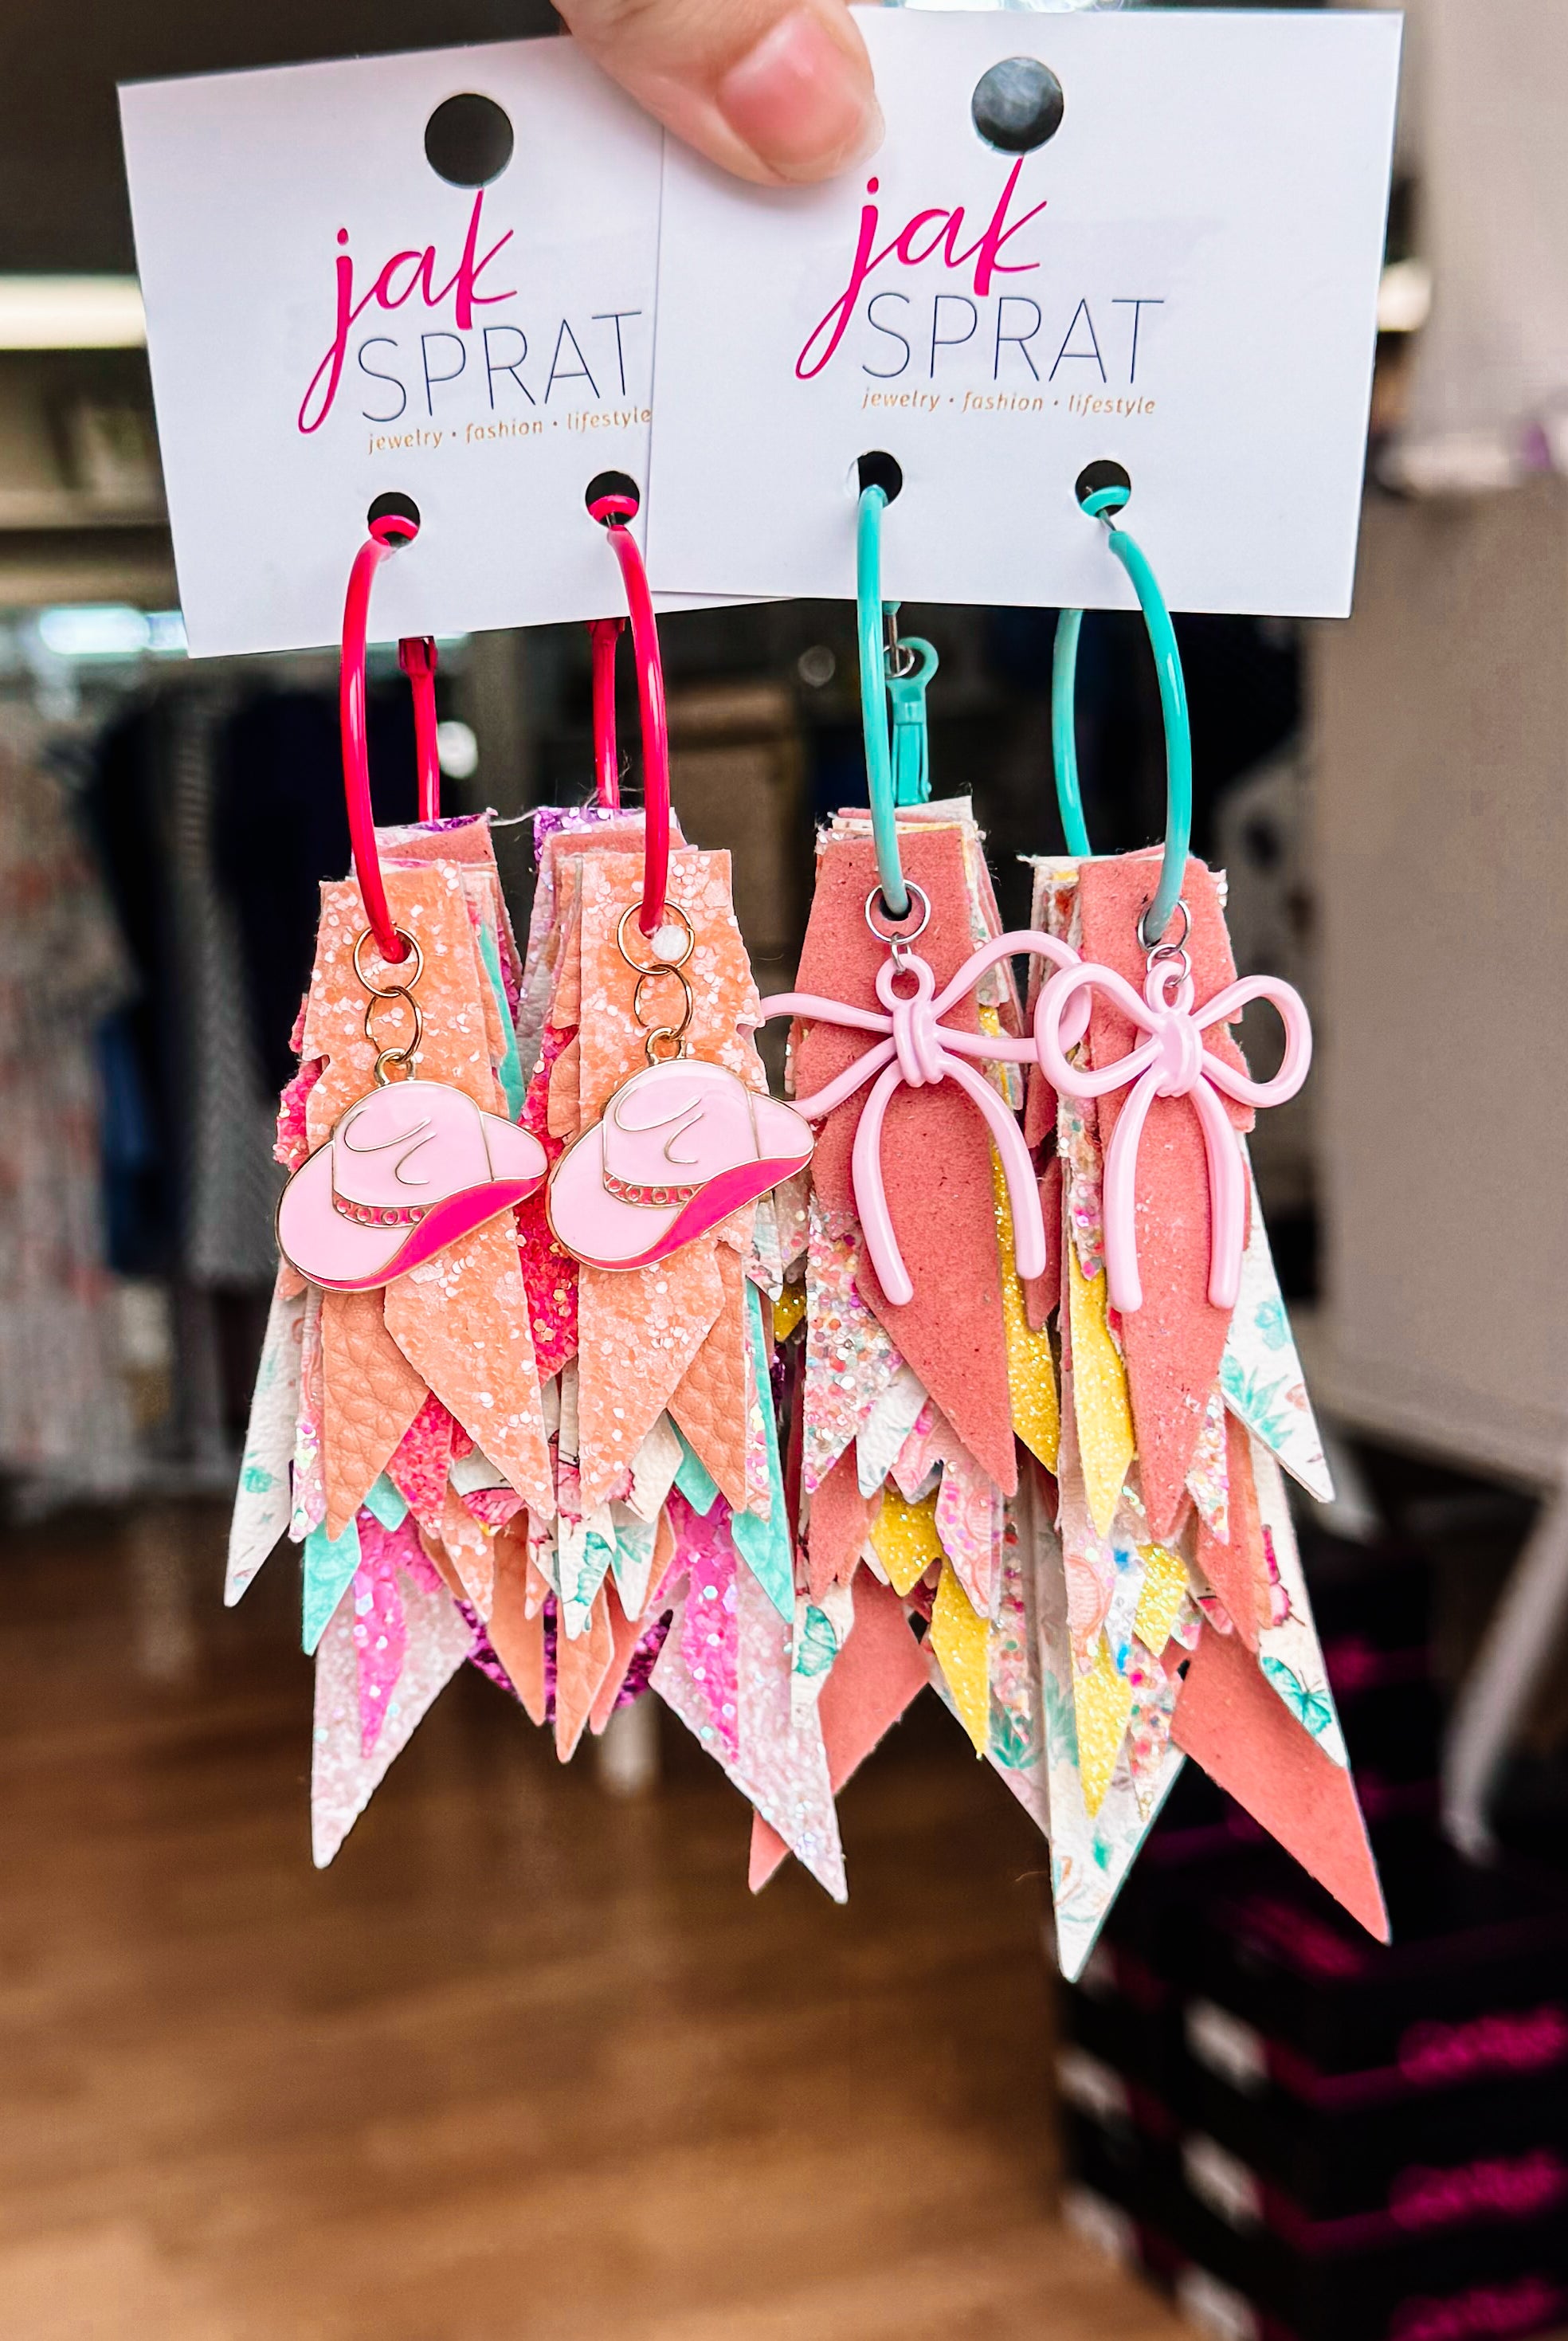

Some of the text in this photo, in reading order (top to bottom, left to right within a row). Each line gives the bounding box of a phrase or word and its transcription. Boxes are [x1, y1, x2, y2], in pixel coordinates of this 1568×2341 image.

[298, 189, 518, 434] jak
[795, 155, 1048, 380] jak
[358, 311, 642, 422] SPRAT
[861, 292, 1165, 384] SPRAT
[368, 406, 653, 455] jewelry fashion lifestyle
[861, 386, 1156, 418] jewelry fashion lifestyle
